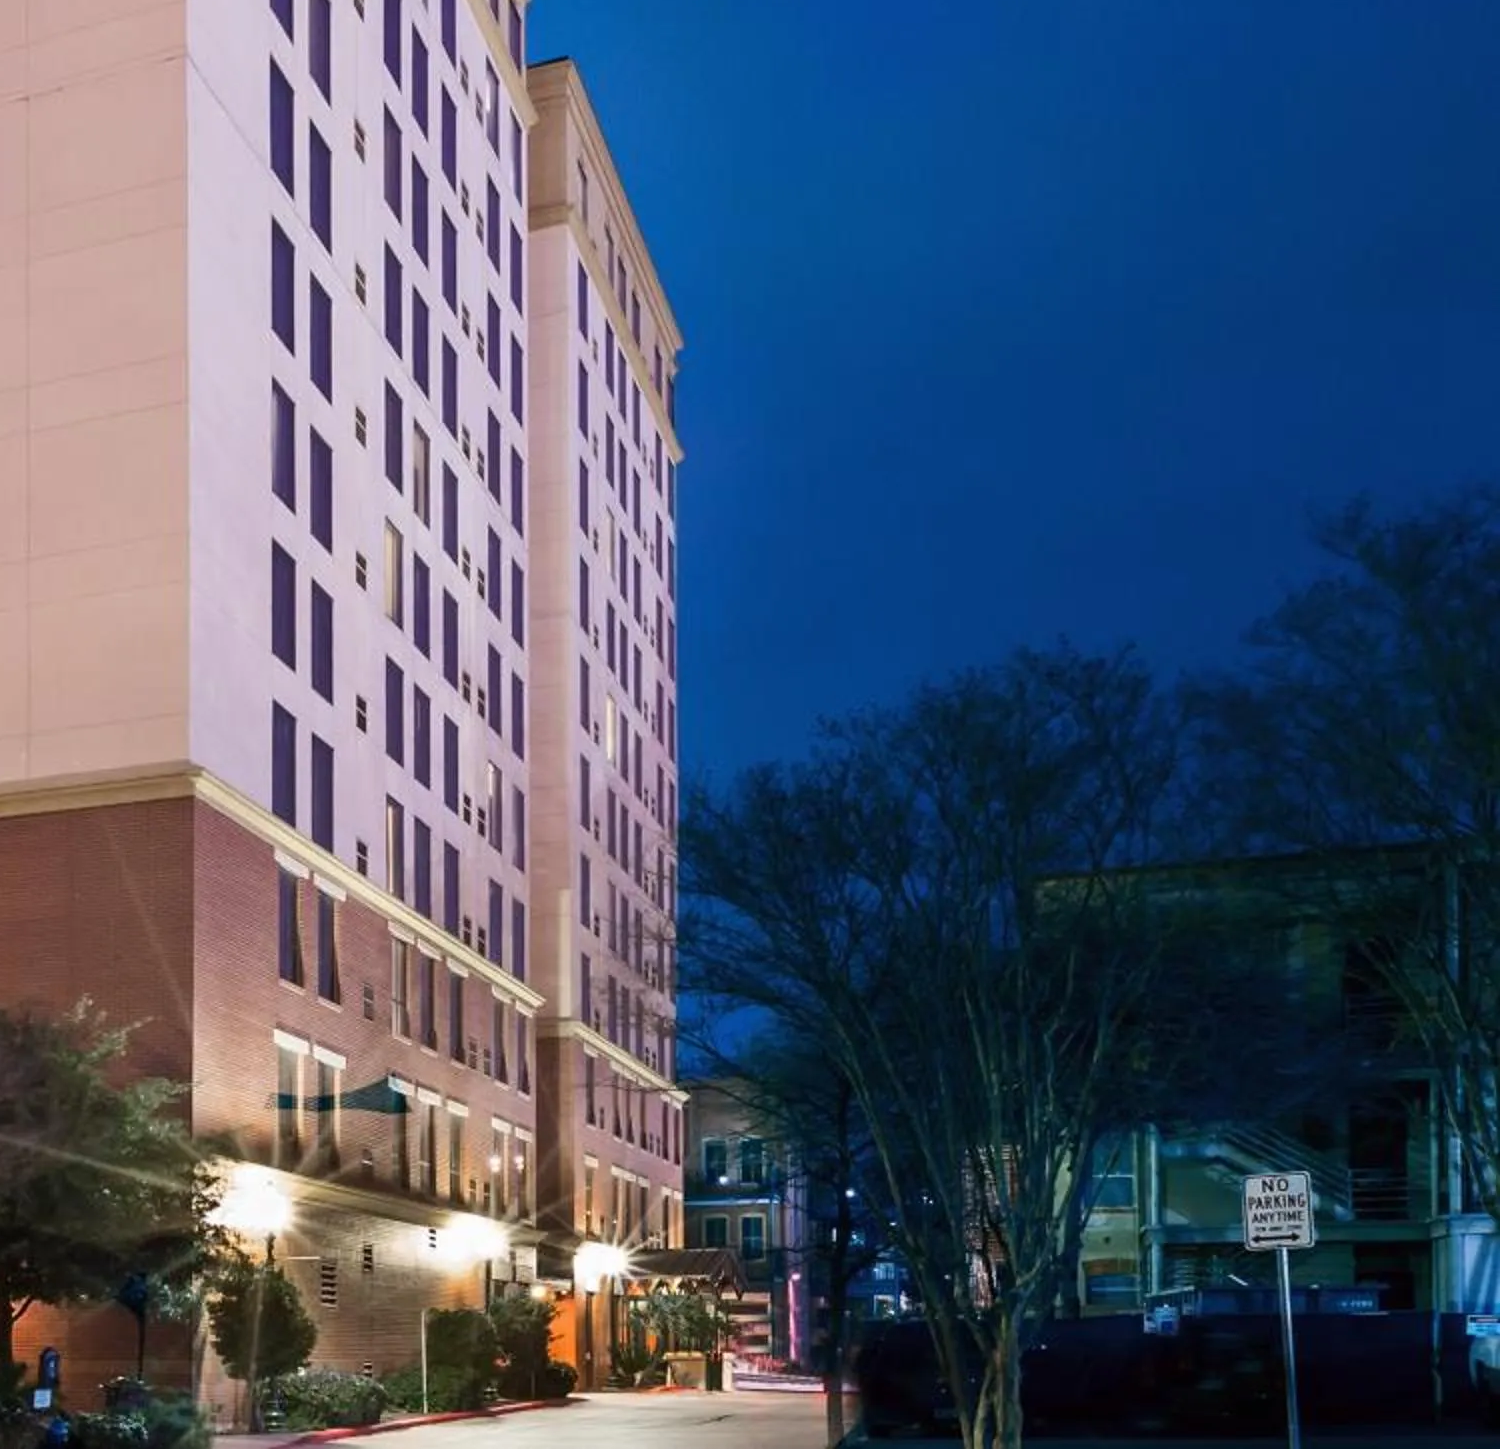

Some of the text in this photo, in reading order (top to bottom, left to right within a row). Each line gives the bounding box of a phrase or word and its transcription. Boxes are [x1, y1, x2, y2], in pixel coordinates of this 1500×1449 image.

[1261, 1178, 1289, 1193] NO
[1248, 1192, 1306, 1211] PARKING
[1252, 1211, 1305, 1224] ANYTIME
